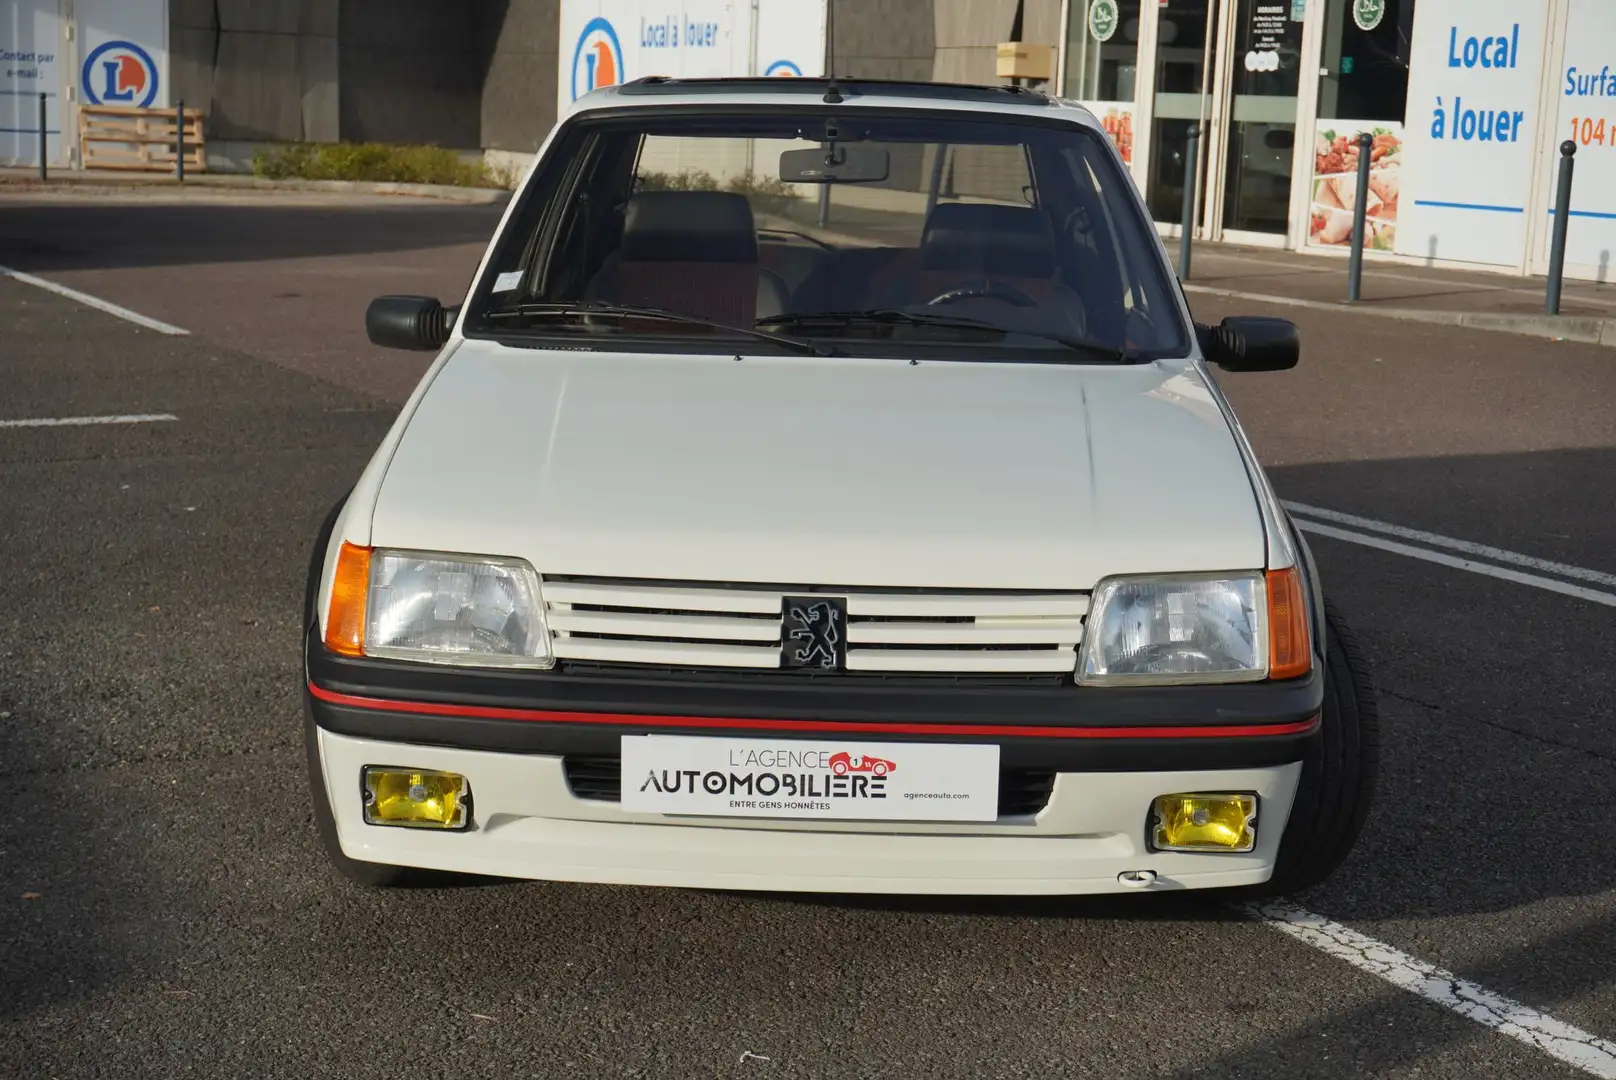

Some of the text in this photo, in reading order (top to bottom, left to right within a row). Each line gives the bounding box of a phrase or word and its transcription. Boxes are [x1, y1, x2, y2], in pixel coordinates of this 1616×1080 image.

[641, 13, 718, 48] Local à louer
[1448, 23, 1520, 69] Local
[38, 54, 54, 64] par
[1431, 96, 1523, 142] à louer
[1571, 117, 1605, 146] 104
[729, 749, 829, 769] L'AGENCE
[729, 800, 831, 811] ENTRE GENS HONNÊTES
[904, 792, 969, 800] agenceauto.com
